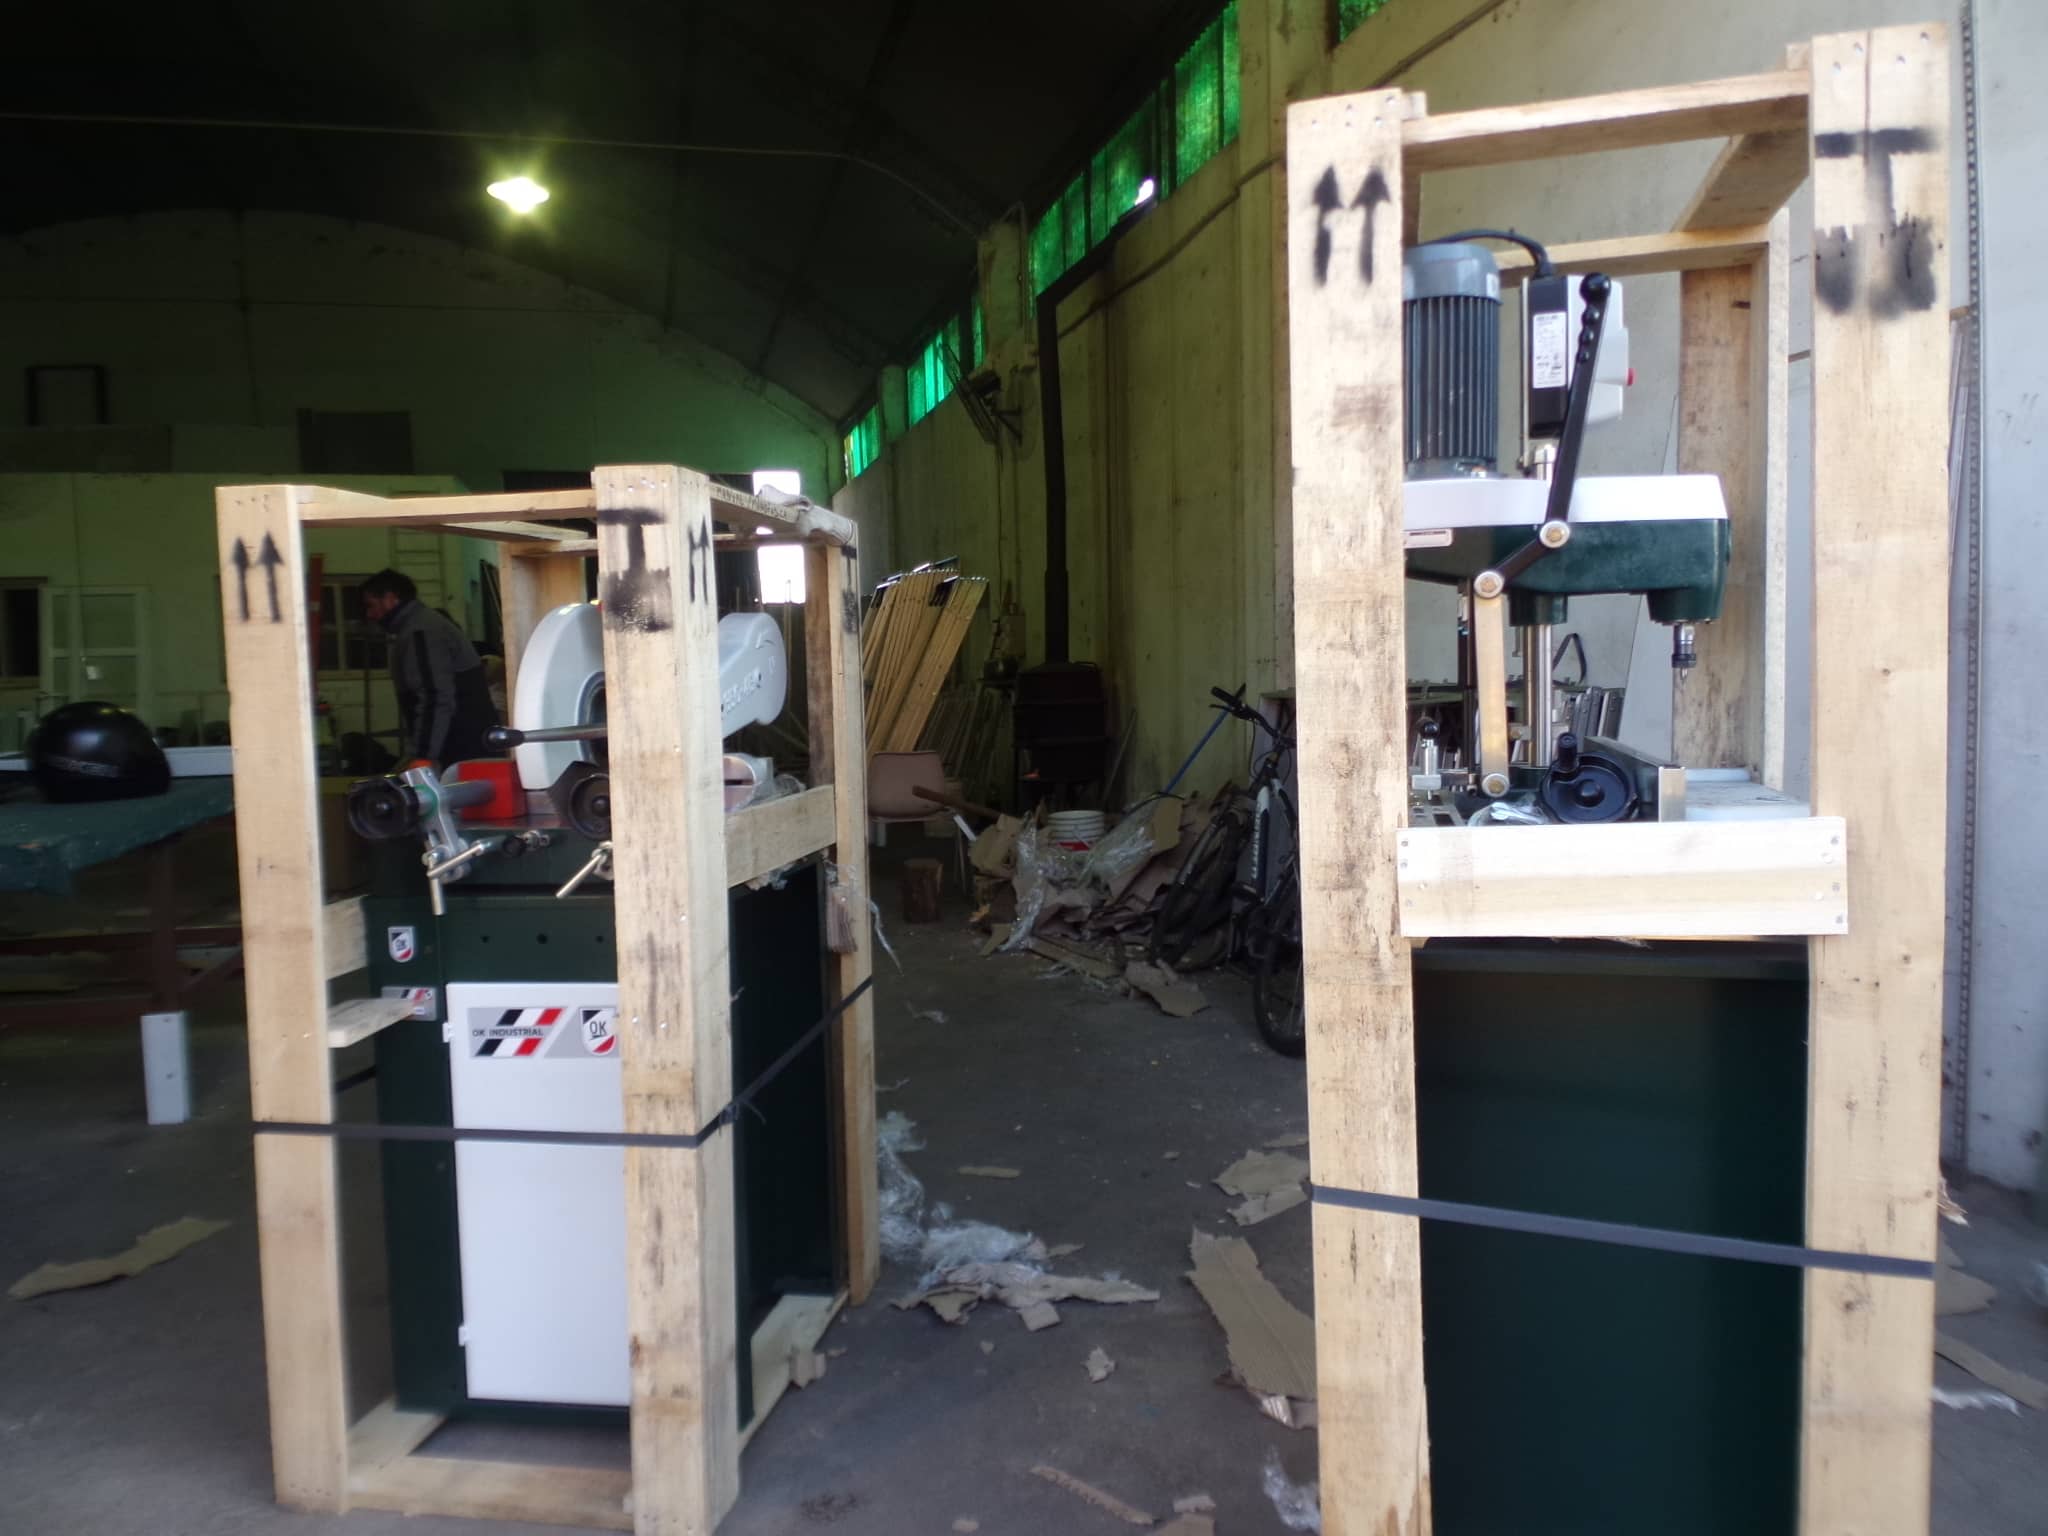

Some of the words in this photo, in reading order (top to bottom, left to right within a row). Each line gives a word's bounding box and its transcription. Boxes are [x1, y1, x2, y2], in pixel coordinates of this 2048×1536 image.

[472, 1029, 486, 1037] OK
[489, 1028, 544, 1037] INDUSTRIAL
[589, 1021, 608, 1035] OK
